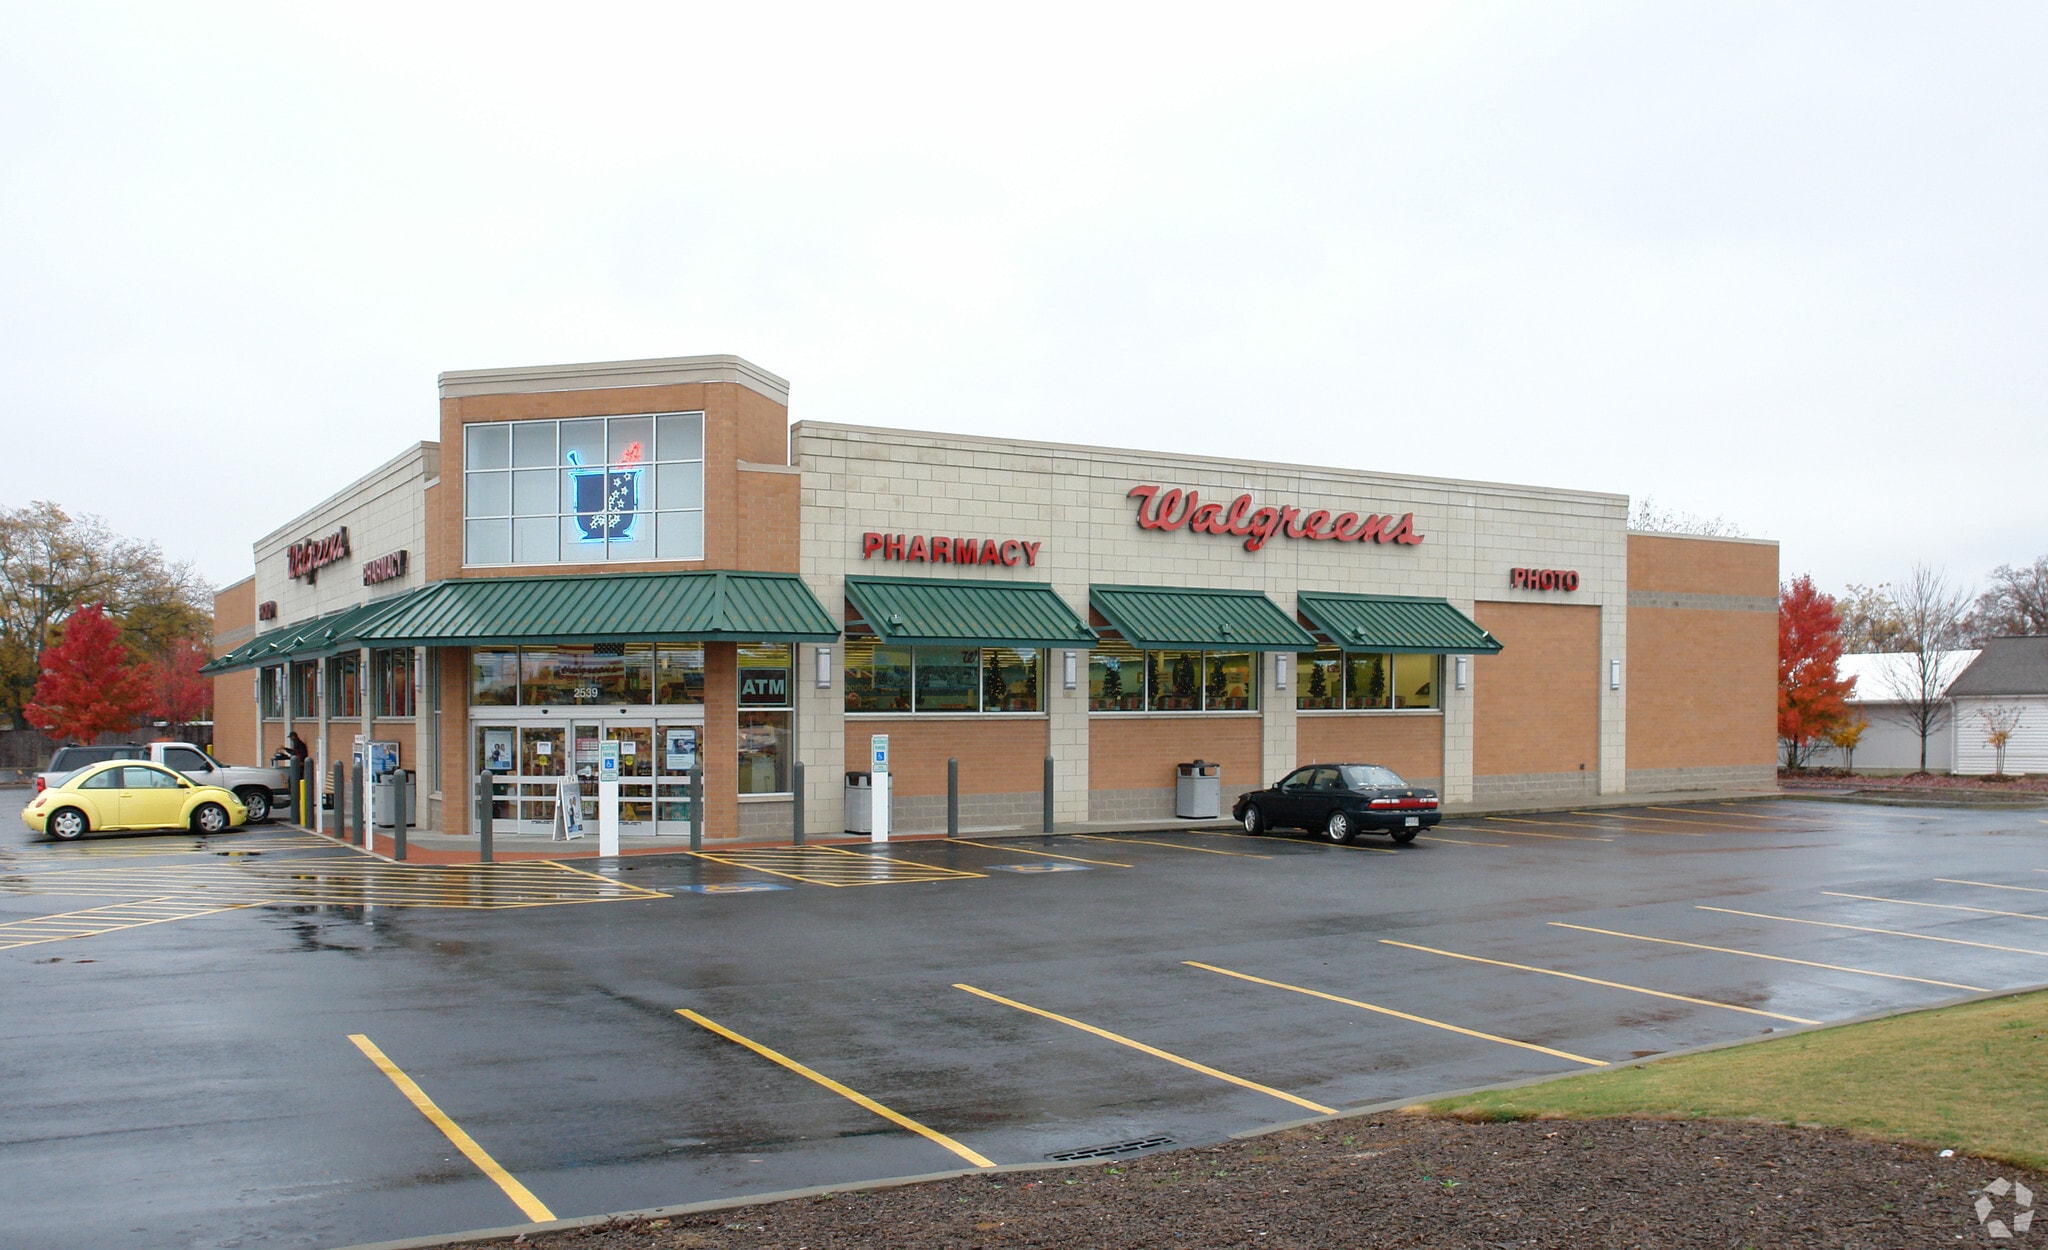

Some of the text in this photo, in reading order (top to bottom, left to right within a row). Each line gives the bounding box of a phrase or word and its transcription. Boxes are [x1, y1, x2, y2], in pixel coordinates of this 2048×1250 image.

[1127, 485, 1425, 552] Walgreens
[862, 532, 1041, 567] PHARMACY
[1510, 567, 1579, 592] PHOTO
[573, 687, 599, 698] 2539
[741, 679, 785, 695] ATM
